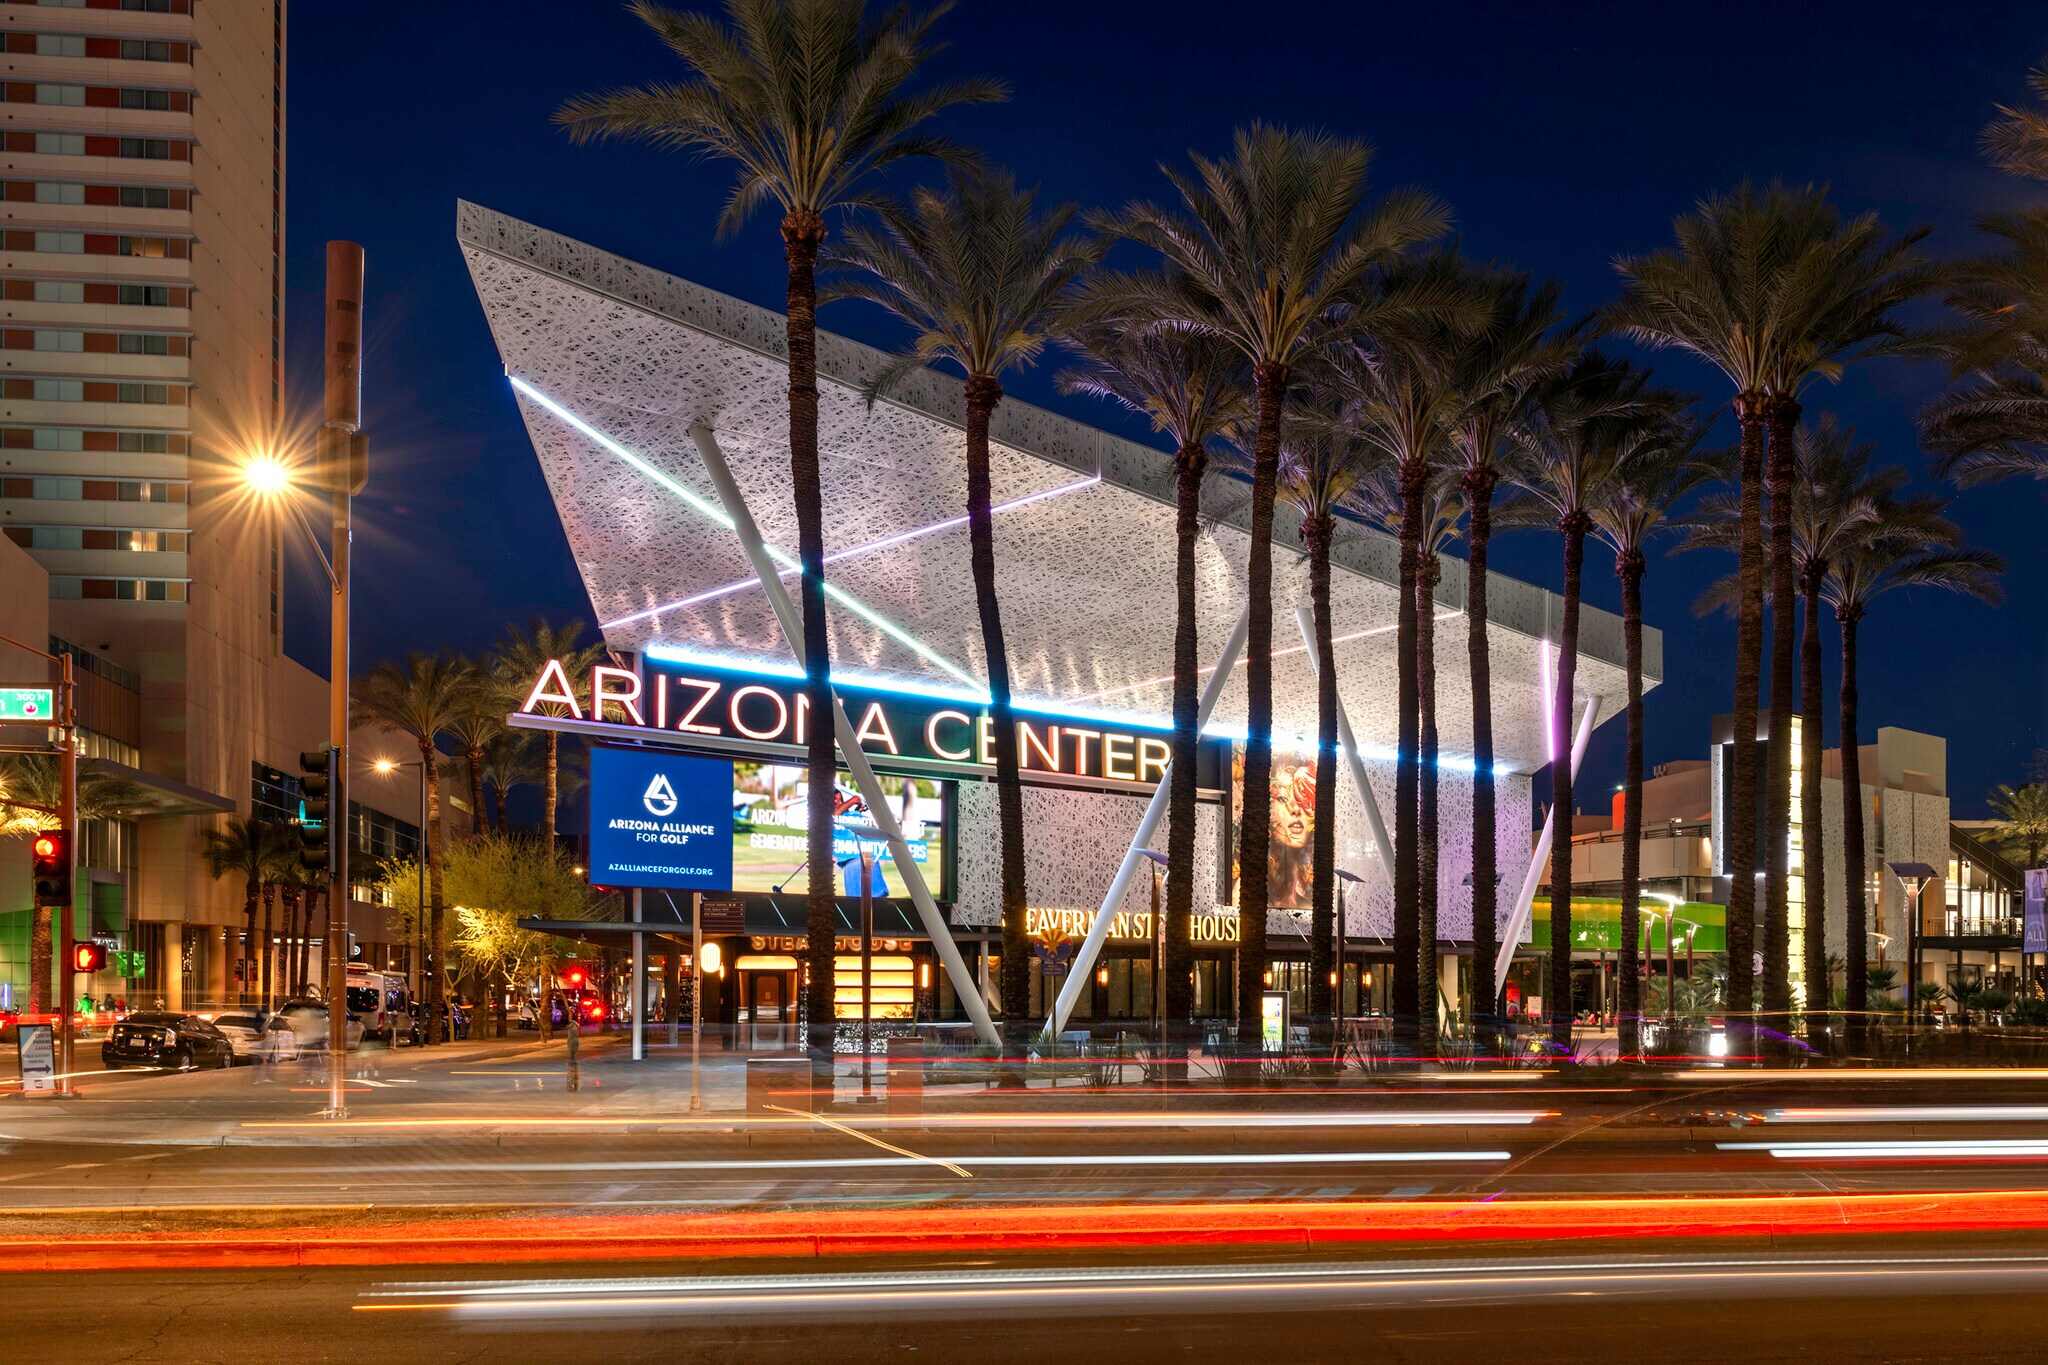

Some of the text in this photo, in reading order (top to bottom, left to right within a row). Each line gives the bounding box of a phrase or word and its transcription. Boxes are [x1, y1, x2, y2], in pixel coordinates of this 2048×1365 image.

[609, 819, 714, 835] ARIZONA ALLIANCE
[636, 833, 689, 844] FOR GOLF
[608, 863, 713, 876] AZALLIANCEFORGOLF.ORG
